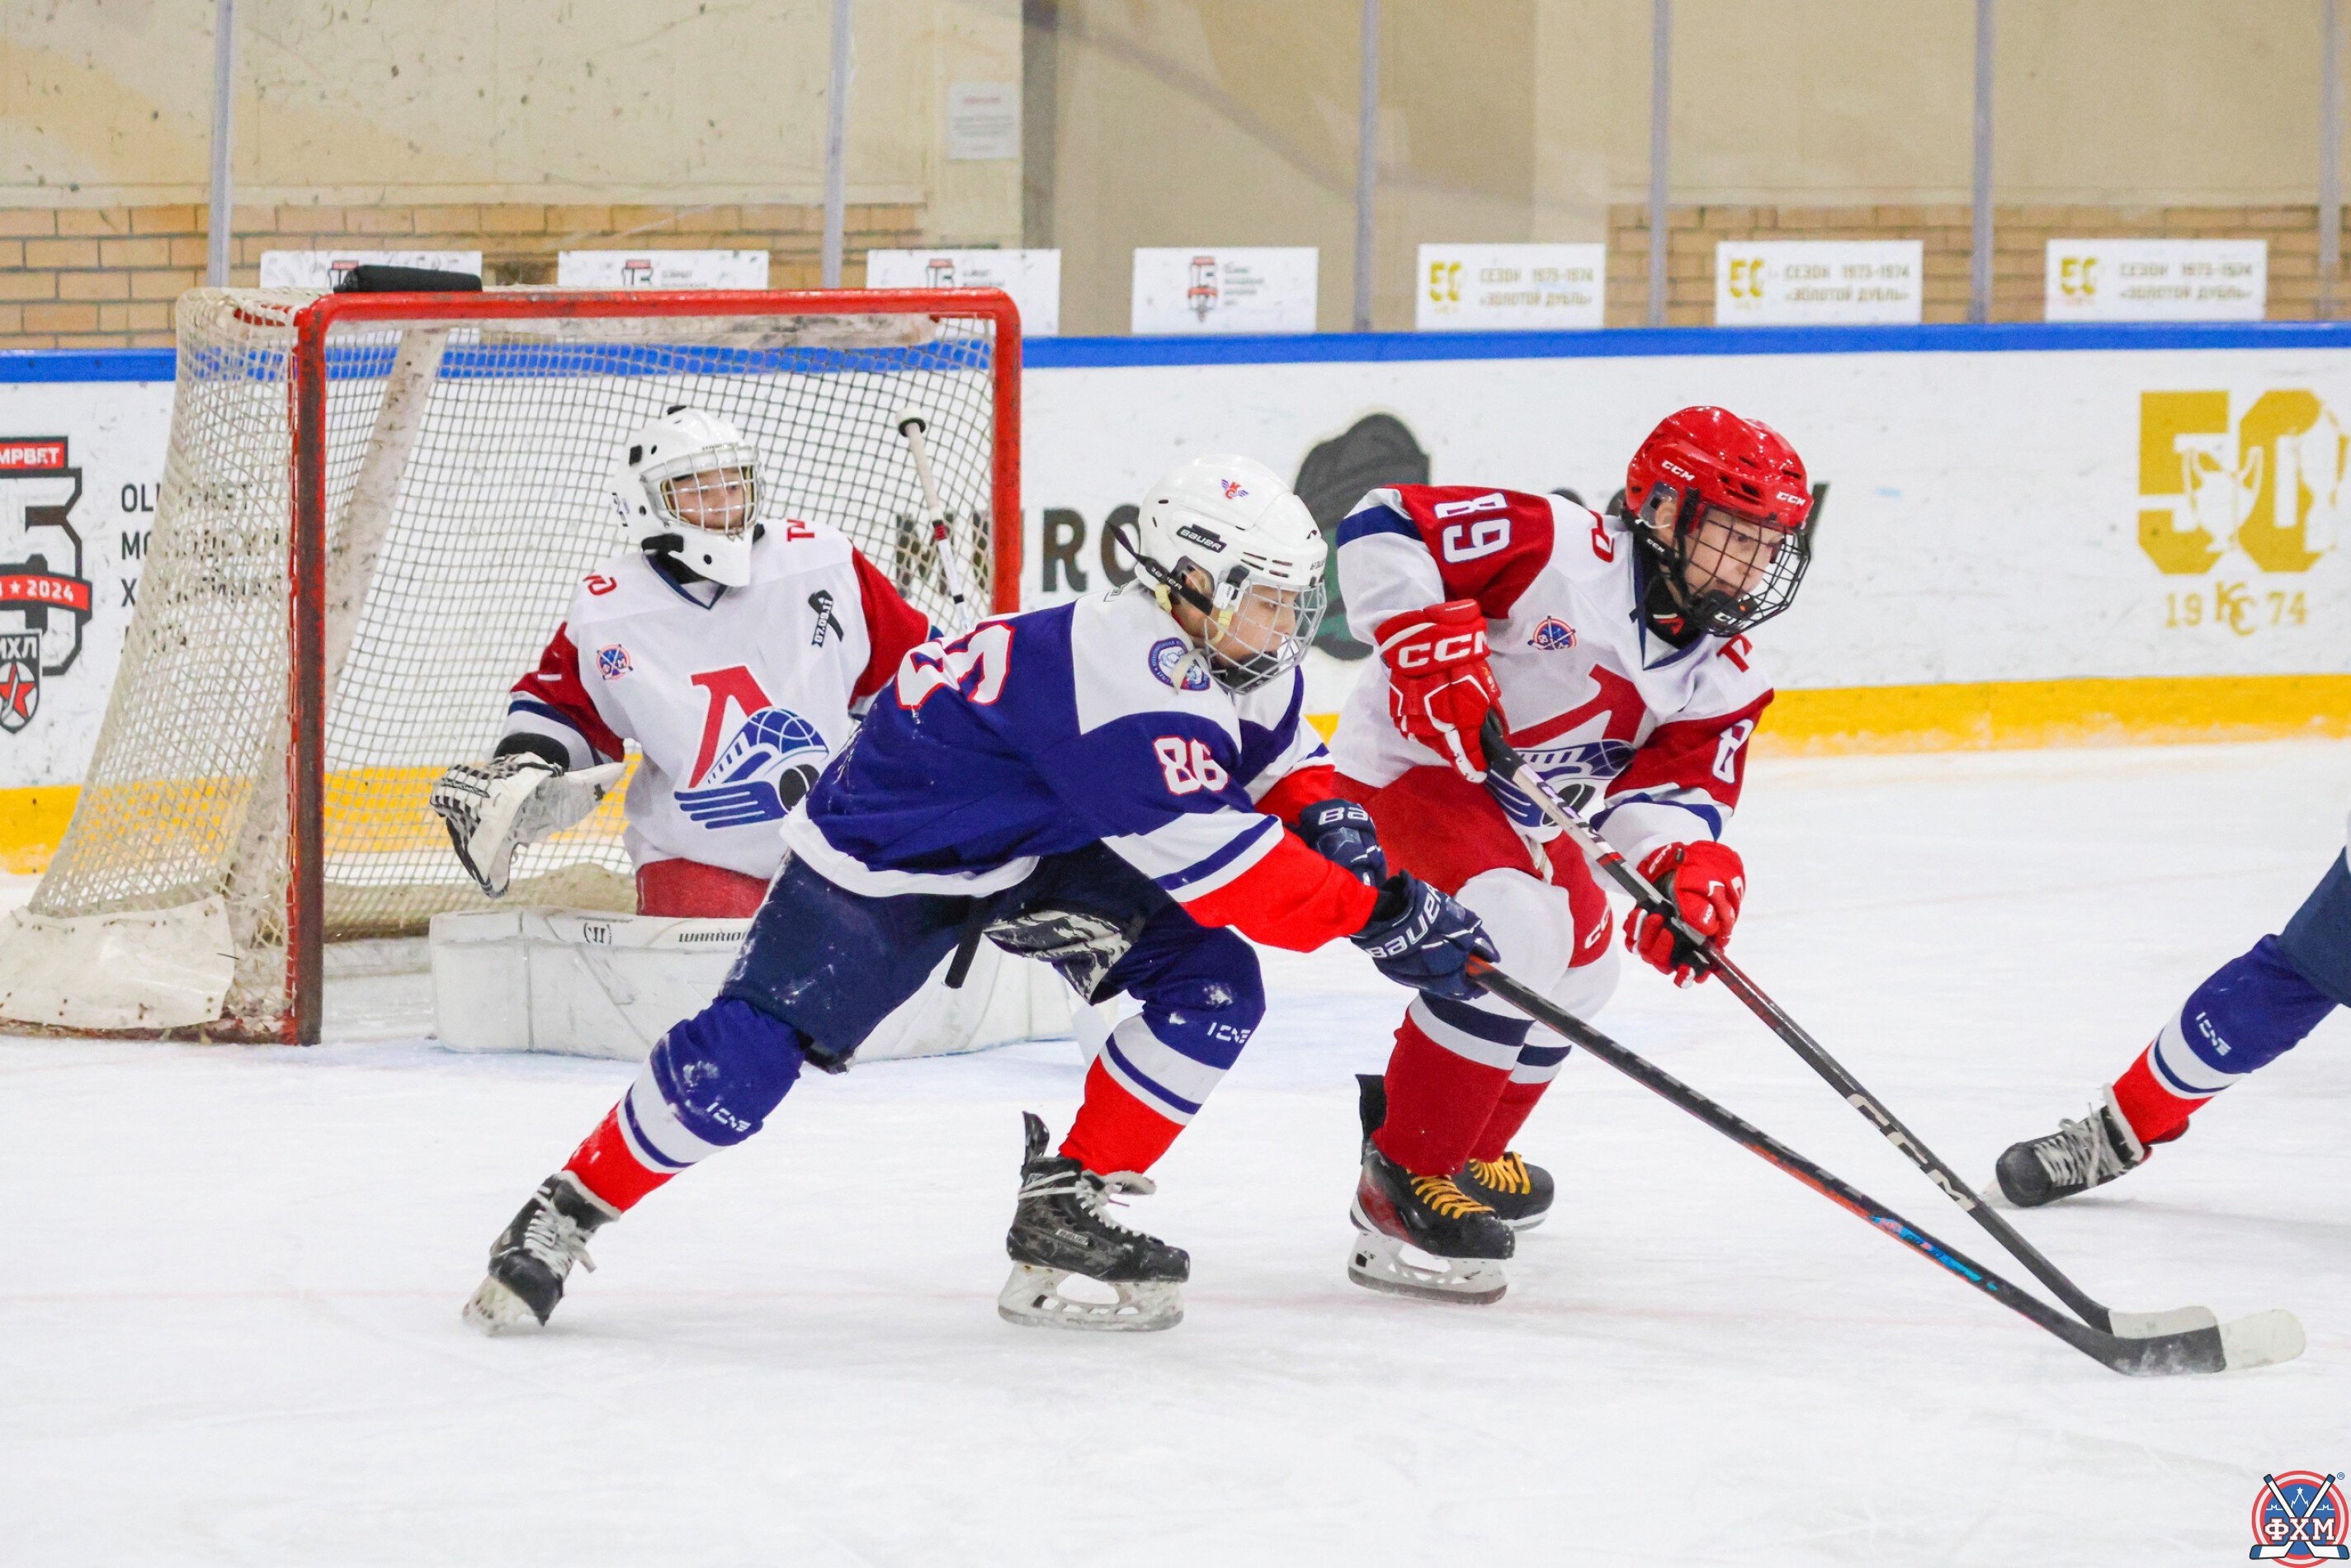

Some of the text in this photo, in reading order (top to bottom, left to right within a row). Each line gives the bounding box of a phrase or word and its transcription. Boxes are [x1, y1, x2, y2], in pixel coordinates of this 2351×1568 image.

[1661, 460, 1695, 481] CCM
[1776, 491, 1806, 506] CCM
[1179, 528, 1222, 550] BAUER
[1435, 492, 1511, 564] 89
[26, 579, 74, 602] 2024
[1153, 734, 1230, 796] 86
[1366, 882, 1442, 959] BAUER
[678, 931, 747, 943] WARRIO
